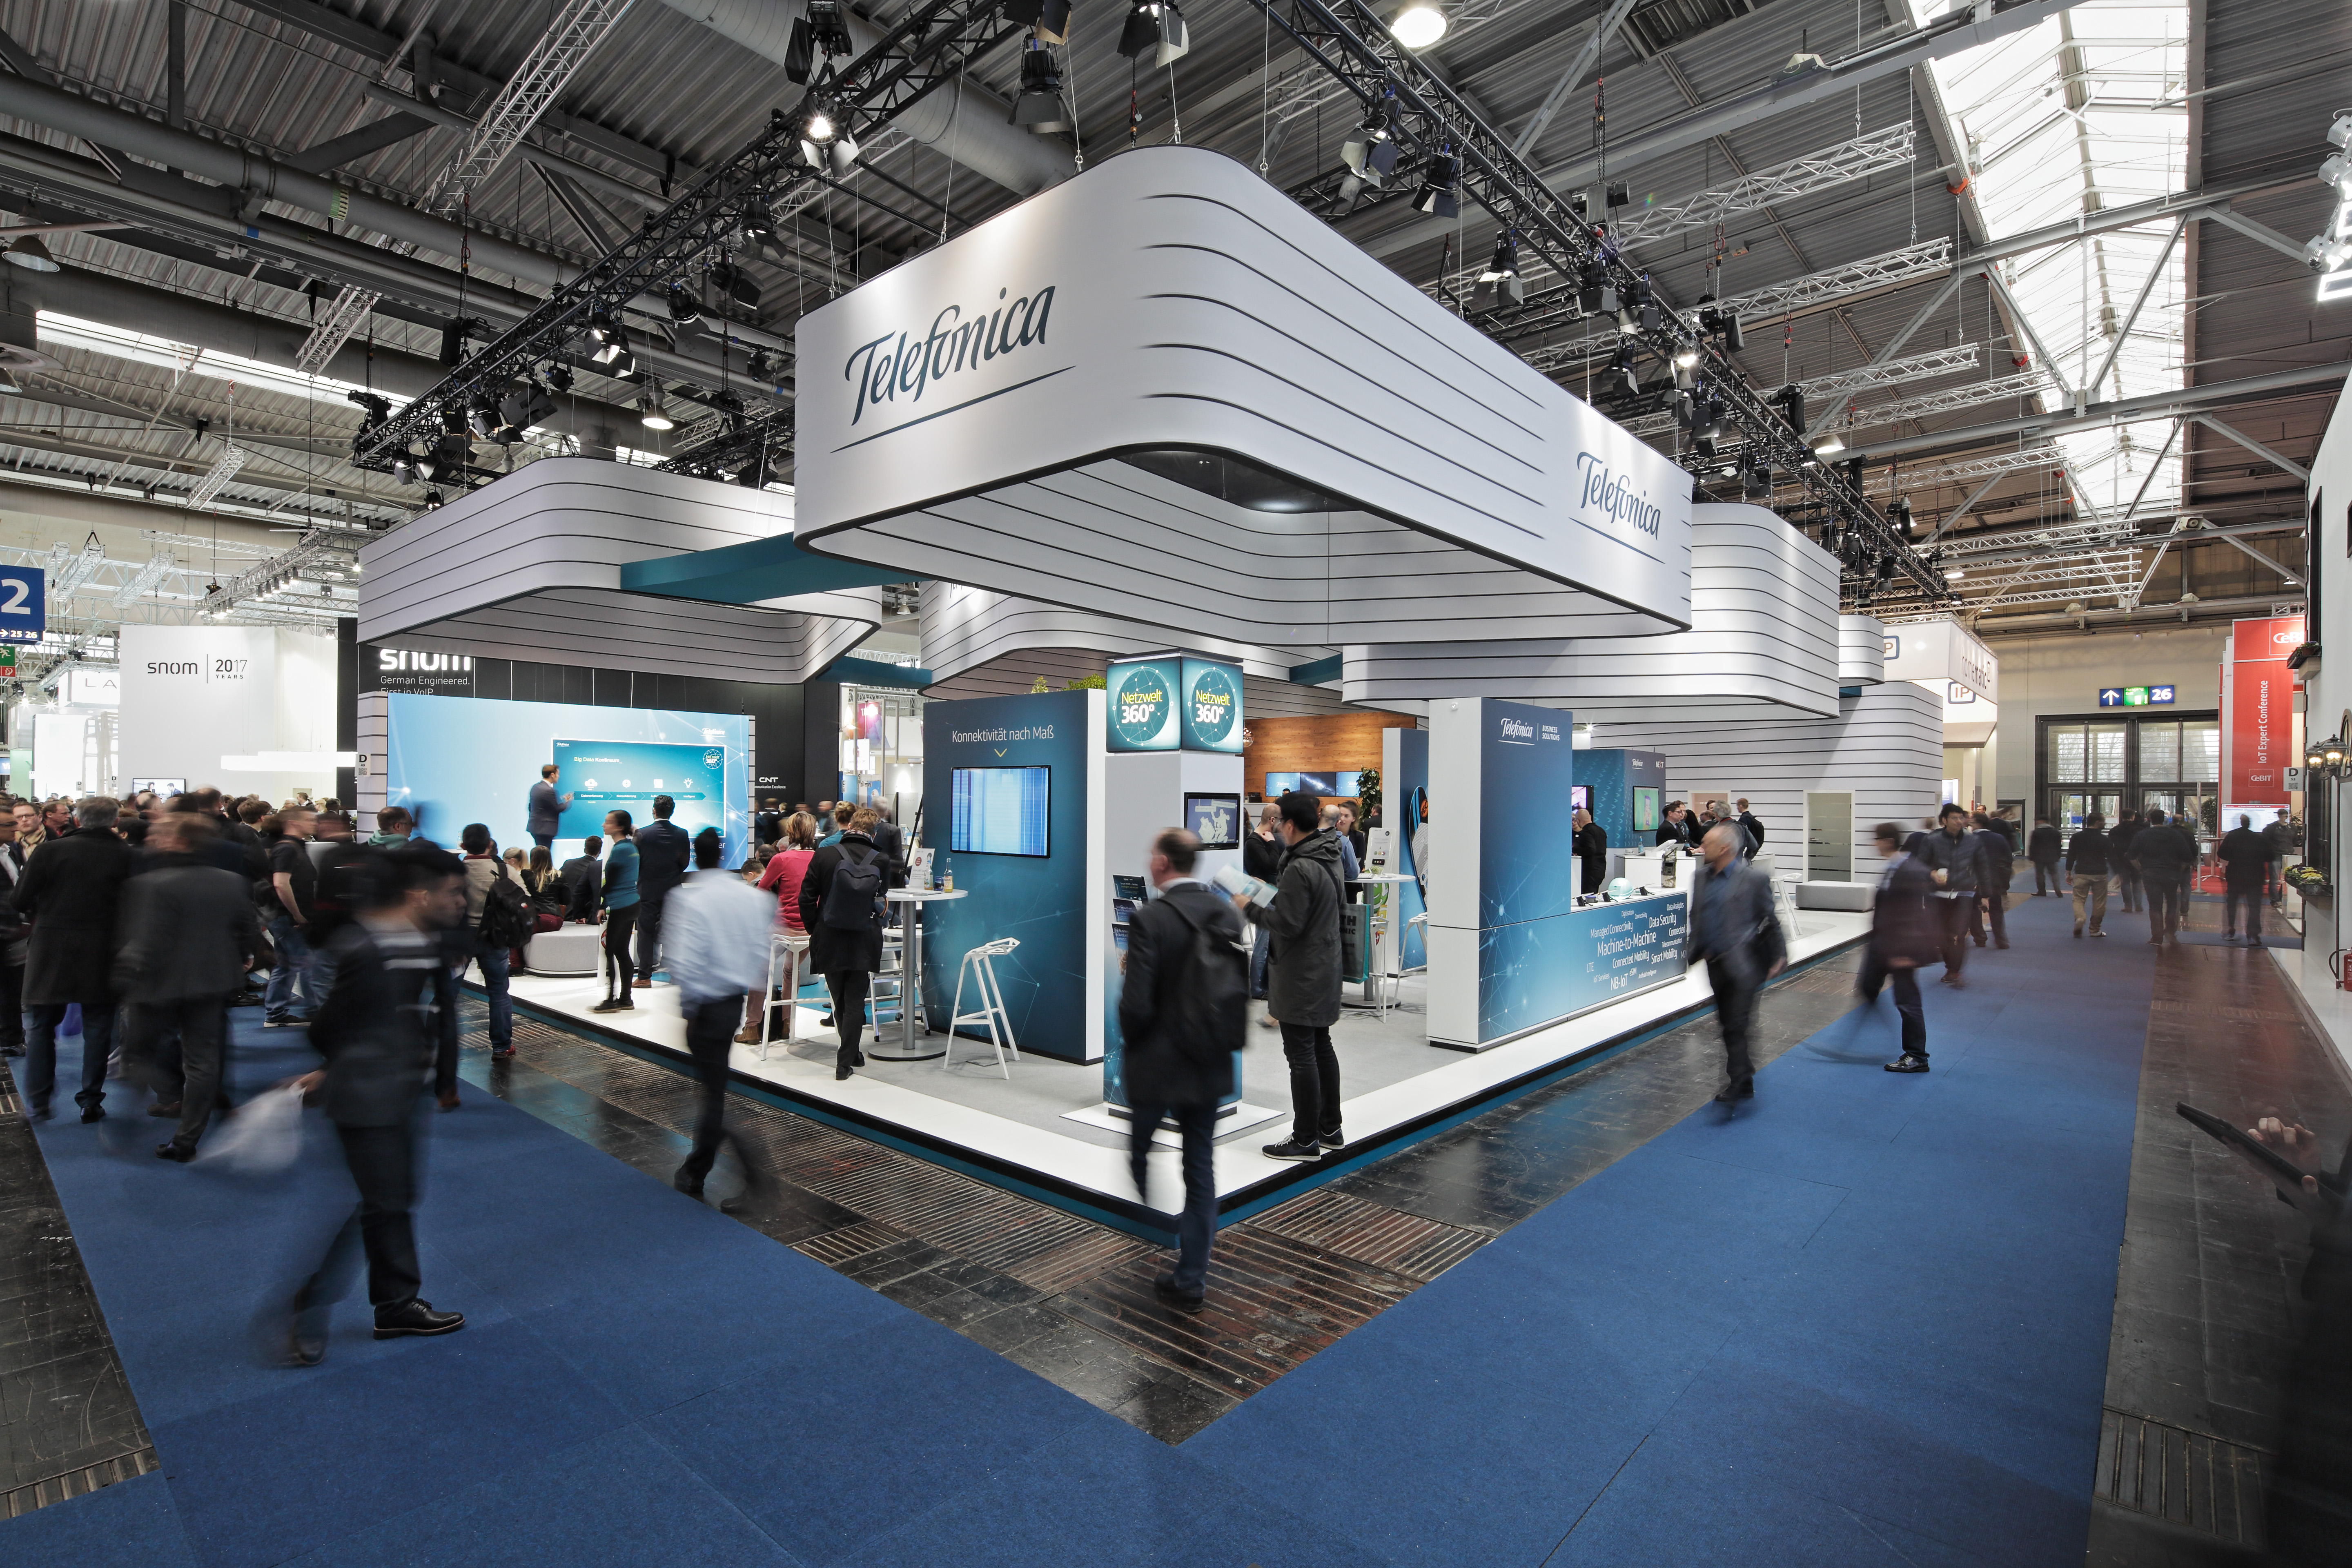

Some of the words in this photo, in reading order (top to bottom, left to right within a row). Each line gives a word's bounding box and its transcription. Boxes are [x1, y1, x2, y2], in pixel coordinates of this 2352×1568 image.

[1, 579, 31, 615] 2
[147, 662, 198, 674] snom
[216, 659, 247, 672] 2017
[1962, 647, 1987, 690] homematic
[381, 676, 416, 684] German
[419, 676, 470, 686] Engineered.
[1121, 688, 1163, 704] Netzwelt
[1196, 689, 1230, 706] Netzwelt
[1956, 687, 1969, 698] IP
[2152, 688, 2172, 700] 26
[2258, 680, 2268, 724] Conference
[952, 728, 1007, 742] Konnektivität
[1009, 726, 1030, 740] nach
[1033, 725, 1054, 739] Maß
[1542, 725, 1558, 733] BUSINESS
[1542, 733, 1560, 741] SOLUTIONS
[2258, 725, 2270, 750] Expert
[359, 754, 367, 762] D
[2258, 751, 2267, 763] IoT
[2288, 768, 2299, 776] D
[1673, 902, 1684, 911] Analytics
[1649, 917, 1659, 928] Data
[1660, 913, 1676, 926] Security
[1590, 924, 1609, 939] Managed
[1609, 921, 1633, 934] Connectivity
[1669, 924, 1685, 937] Connected
[1597, 930, 1656, 957] Machine-to-Machine
[1662, 938, 1683, 948] Telecommunication
[1612, 953, 1633, 969] Connected
[1634, 950, 1649, 962] Mobility
[1651, 952, 1662, 964] Smart
[1663, 948, 1677, 960] Mobility
[1598, 973, 1610, 982] Services
[1610, 973, 1628, 991] NB-IoT
